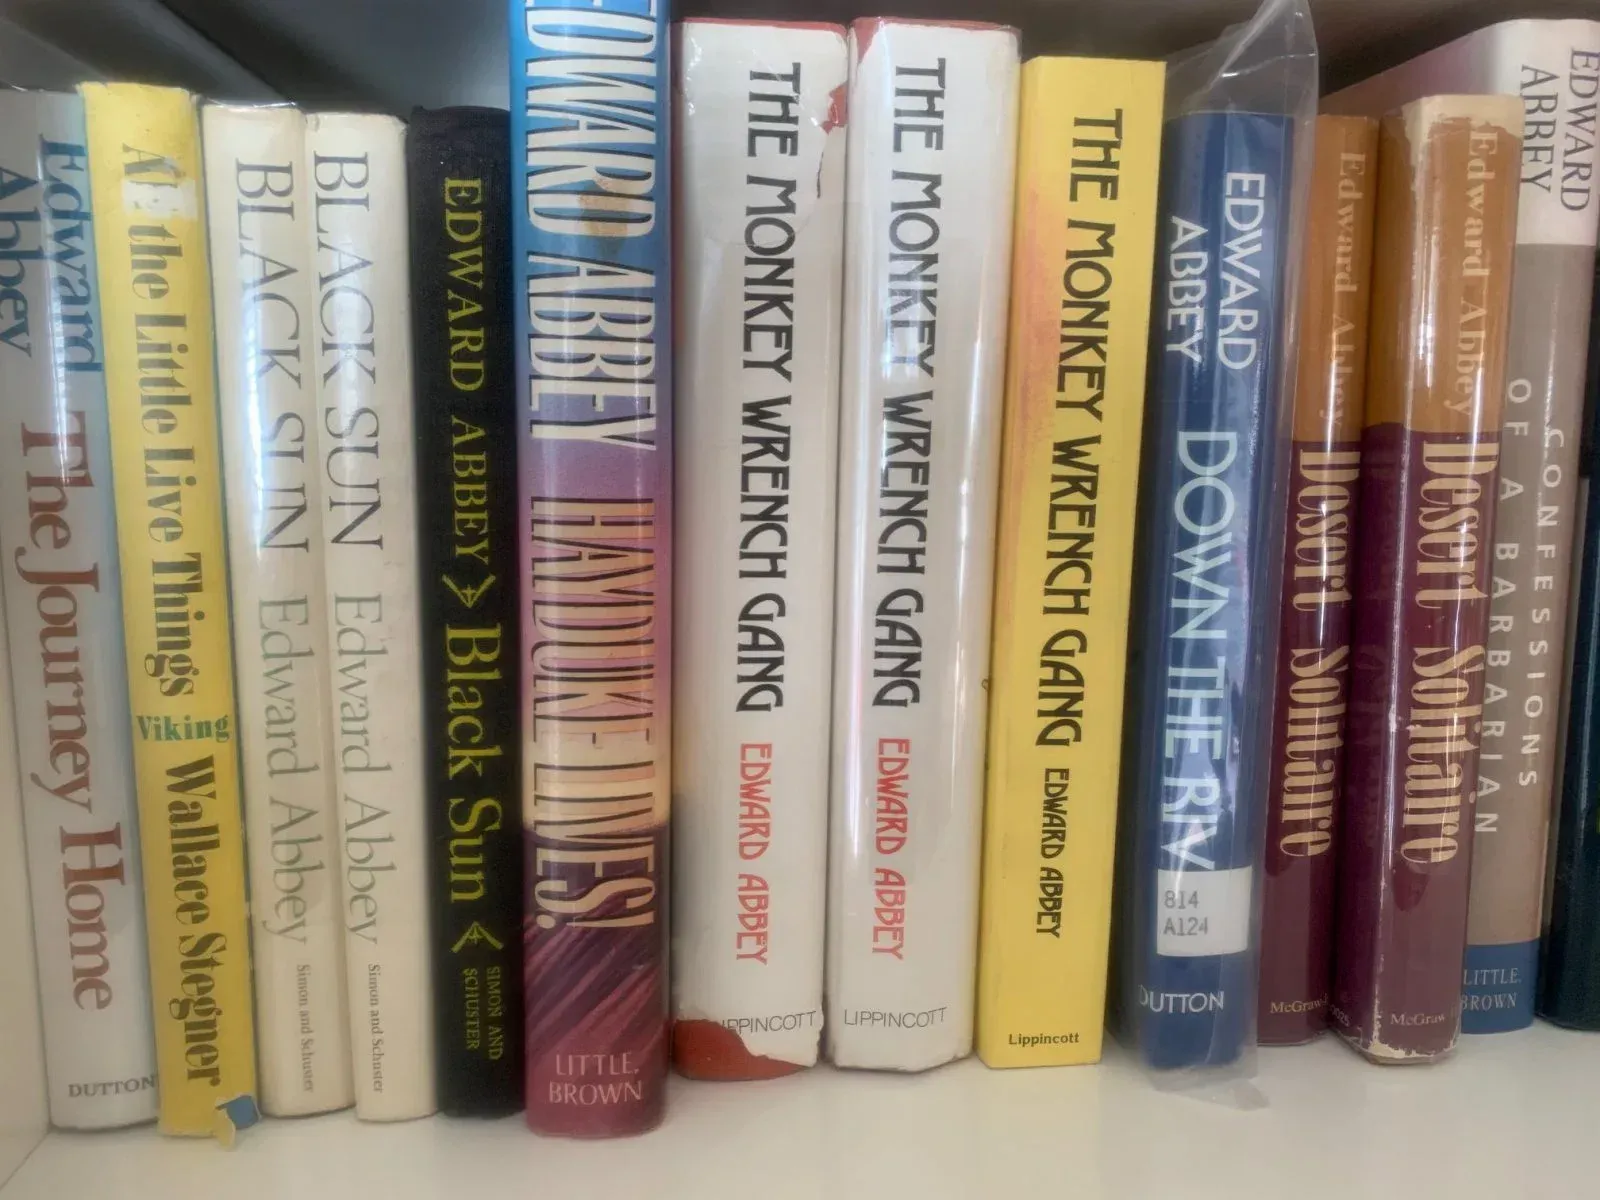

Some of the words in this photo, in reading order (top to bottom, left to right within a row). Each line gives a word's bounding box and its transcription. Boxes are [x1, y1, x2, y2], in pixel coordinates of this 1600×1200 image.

[526, 0, 657, 237] DWARD
[747, 62, 802, 158] THE
[892, 57, 947, 154] THE
[1068, 107, 1124, 204] THE
[1560, 48, 1600, 211] EDWARD
[0, 166, 47, 359] Abbey
[39, 133, 104, 373] Edward
[127, 223, 184, 300] the
[235, 156, 303, 390] BLACK
[313, 150, 377, 385] BLACK
[885, 169, 943, 379] MONKEY
[1218, 171, 1266, 371] EDWARD
[1334, 152, 1366, 293] Edward
[1462, 131, 1498, 277] Edward
[442, 177, 487, 393] EDWARD
[743, 175, 798, 384] MONKEY
[1055, 217, 1117, 426] MONKEY
[1165, 214, 1209, 364] ABBEY
[134, 312, 193, 435] Little
[527, 251, 657, 452] ABBEY
[1443, 296, 1487, 417] Abbey
[1504, 378, 1532, 437] OF
[21, 409, 95, 550] The
[143, 445, 197, 544] Live
[260, 411, 310, 553] SUN
[324, 406, 384, 551] SUN
[450, 414, 491, 566] ABBEY
[738, 394, 793, 582] WRENCH
[876, 391, 934, 576] WRENCH
[1042, 432, 1102, 616] WRENCH
[1170, 431, 1238, 642] DOWN
[1292, 449, 1361, 612] Desert
[1415, 441, 1499, 609] Desert
[1501, 477, 1524, 501] A
[144, 552, 206, 698] Things
[530, 496, 656, 750] HAYDUKE
[736, 592, 787, 713] GANG
[871, 588, 925, 708] GANG
[1518, 429, 1565, 788] CONFESSIONS
[14, 546, 101, 814] Journey
[135, 713, 231, 743] Viking
[257, 595, 320, 780] Edward
[334, 593, 393, 775] Edward
[445, 625, 503, 780] Black
[1035, 628, 1088, 748] GANG
[1165, 660, 1226, 760] THE
[1475, 542, 1520, 833] BARBARIAN
[738, 742, 773, 862] EDWARD
[875, 737, 911, 856] EDWARD
[1040, 767, 1070, 860] EDWARD
[1160, 776, 1221, 870] RIV
[1400, 644, 1486, 863] Solitaire
[164, 753, 222, 928] Wallace
[261, 795, 326, 945] Abbey
[343, 794, 398, 945] Abbey
[448, 796, 502, 905] Sun
[533, 760, 656, 929] LIVES!
[1036, 866, 1062, 940] ABBEY
[1163, 889, 1200, 910] 814
[59, 821, 125, 1011] Home
[736, 872, 771, 966] ABBEY
[871, 866, 907, 962] ABBEY
[1163, 916, 1209, 937] A124
[168, 931, 227, 1088] Stegner
[297, 964, 311, 1007] Simon
[299, 1009, 314, 1035] and
[368, 963, 381, 1007] Simon
[369, 1009, 384, 1035] and
[463, 967, 481, 1050] SCHUSTER
[487, 966, 503, 1017] SIMON
[488, 1025, 504, 1061] AND
[843, 1006, 948, 1031] LIPPINCOTT
[1008, 1030, 1080, 1048] Lippincott
[68, 1073, 157, 1098] DUTTON
[300, 1038, 315, 1093] Schuster
[371, 1038, 385, 1093] Schuster
[549, 1080, 643, 1106] BROWN
[556, 1051, 640, 1076] LITTLE,
